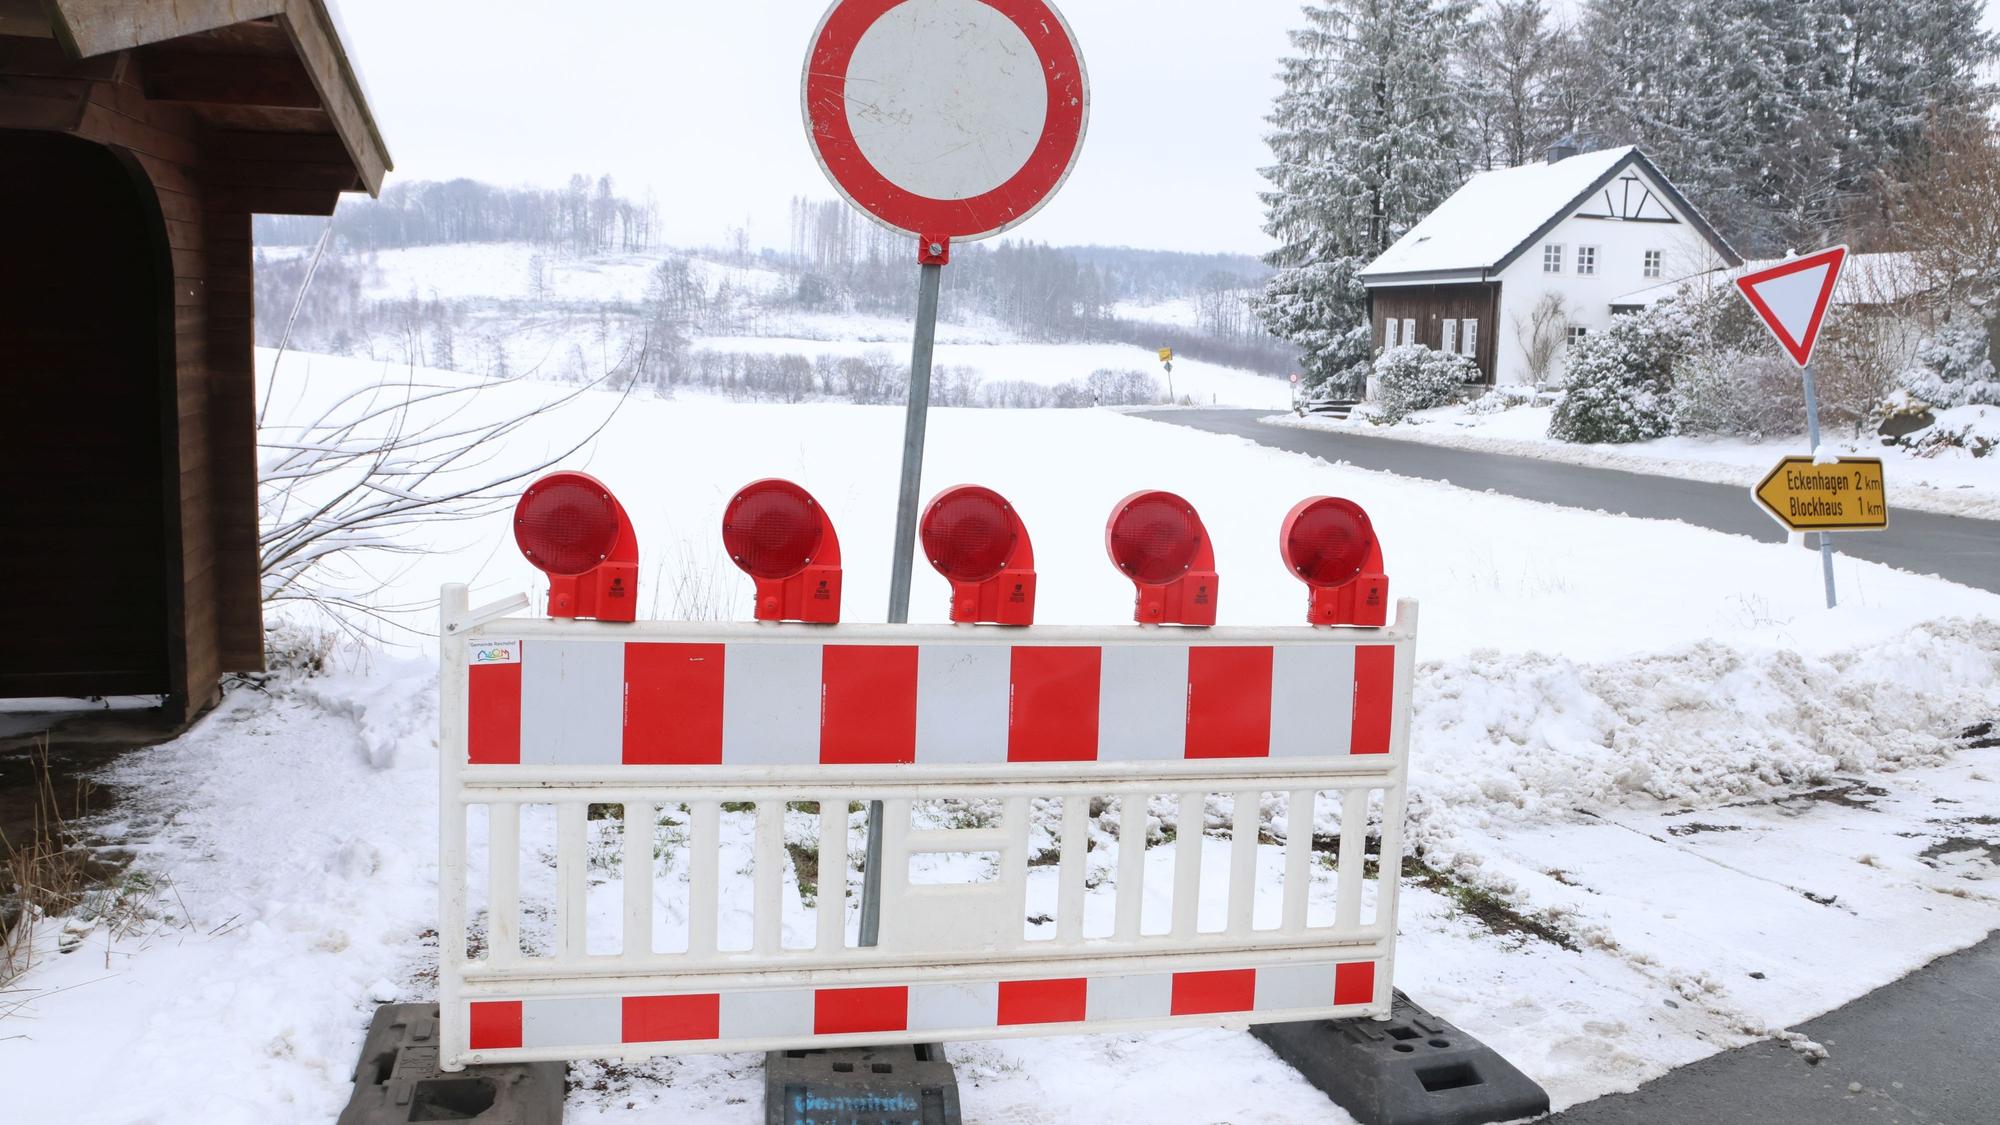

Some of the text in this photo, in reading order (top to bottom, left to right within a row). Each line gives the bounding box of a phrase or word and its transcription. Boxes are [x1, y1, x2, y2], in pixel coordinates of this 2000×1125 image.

[1786, 470, 1880, 495] Eckenhagen 2 km
[1789, 496, 1882, 516] Blockhaus 1 km
